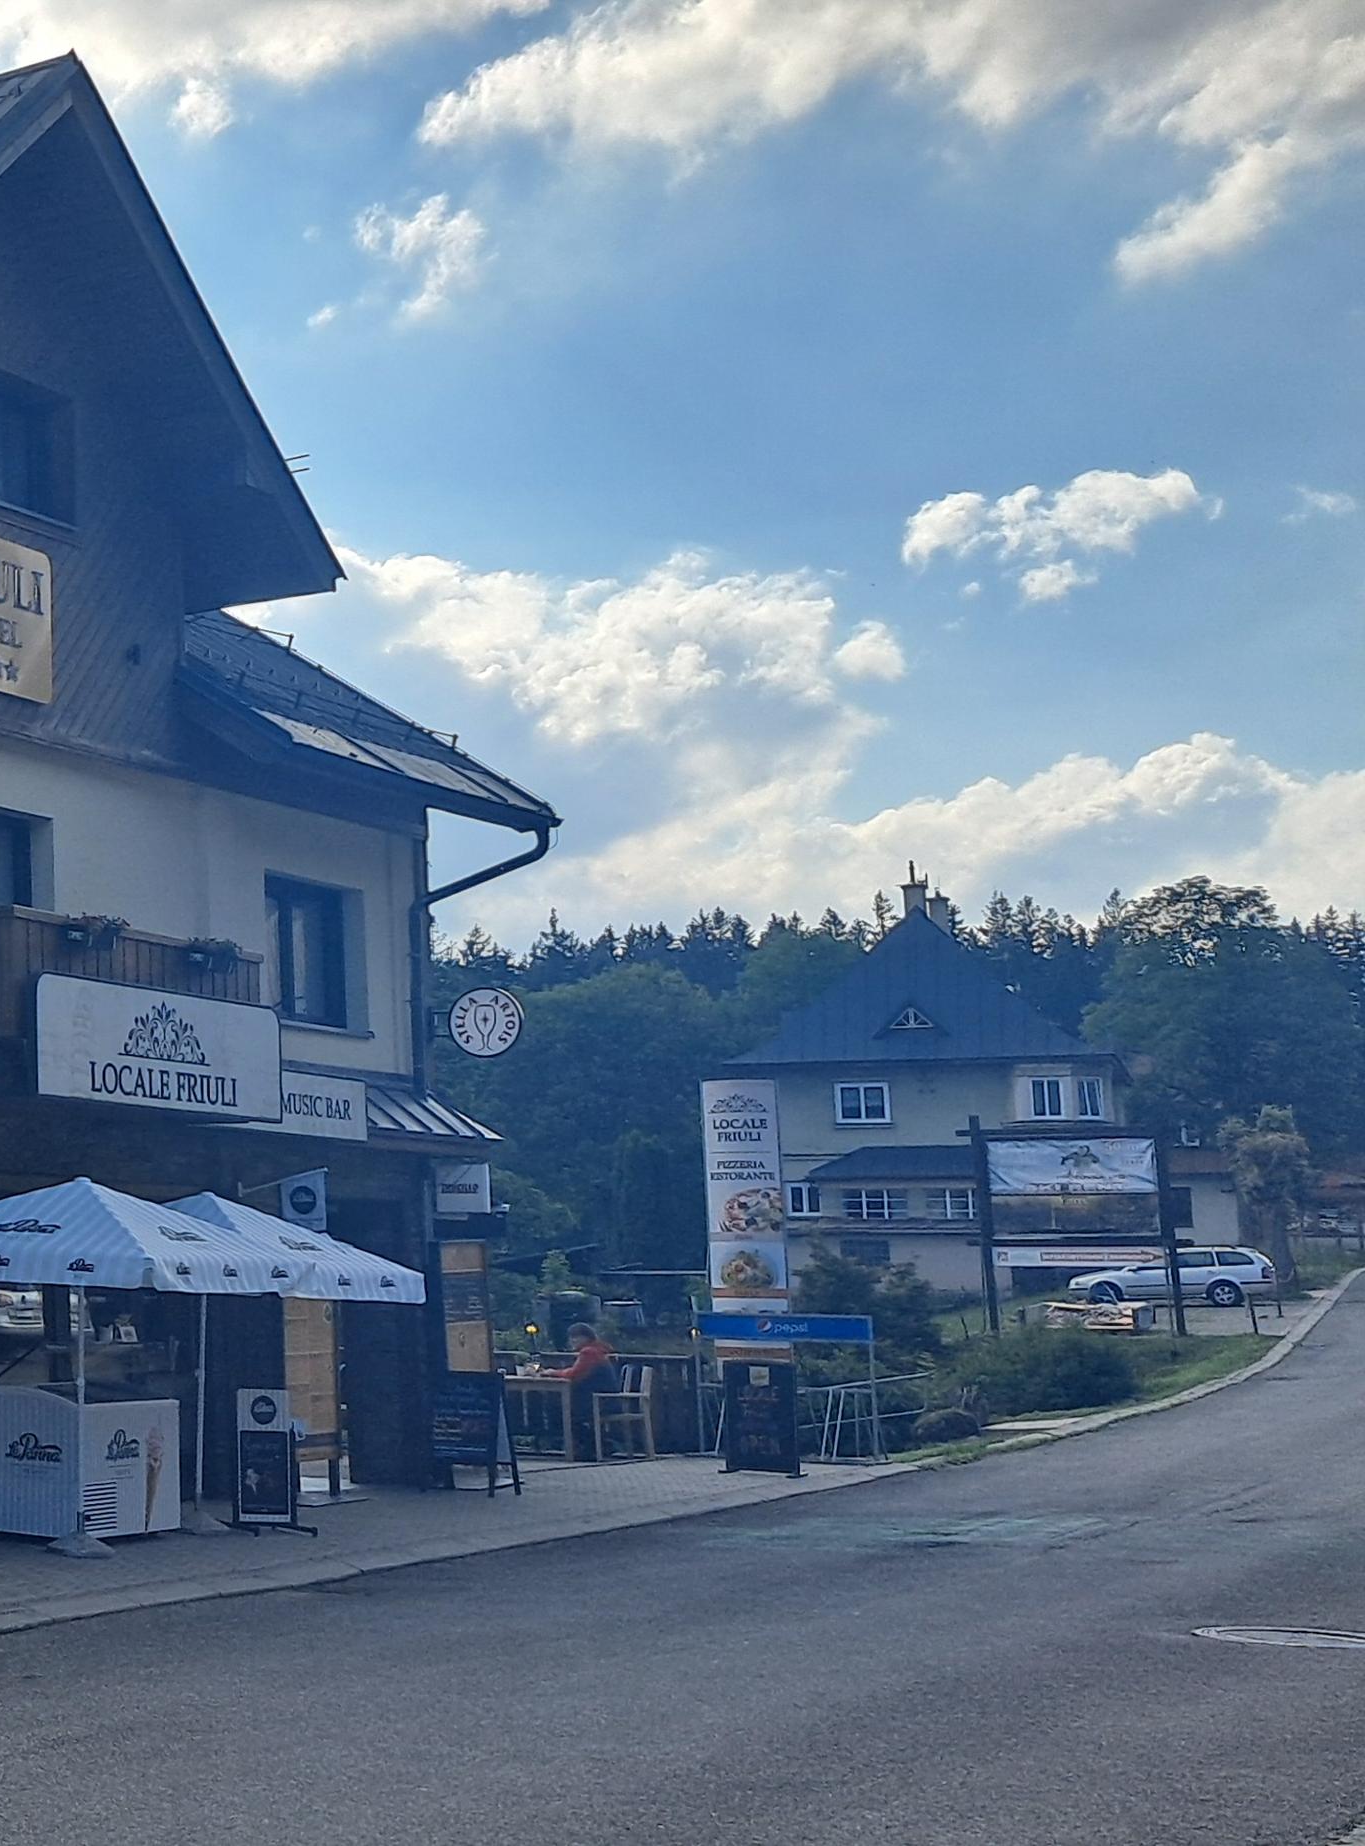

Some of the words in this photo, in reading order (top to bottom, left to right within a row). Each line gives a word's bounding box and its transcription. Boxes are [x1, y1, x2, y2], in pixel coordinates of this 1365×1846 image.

[455, 997, 478, 1045] STELLA
[489, 995, 516, 1045] ARTOIS
[89, 1061, 170, 1100] LOCALE
[176, 1071, 238, 1108] FRIULI
[281, 1092, 323, 1118] MUSIC
[325, 1096, 352, 1121] BAR
[712, 1118, 768, 1130] LOCALE
[717, 1131, 762, 1142] FRIULI
[716, 1160, 766, 1170] PIZZERIA
[710, 1172, 776, 1181] RISTORANTE
[773, 1321, 809, 1333] pepsi
